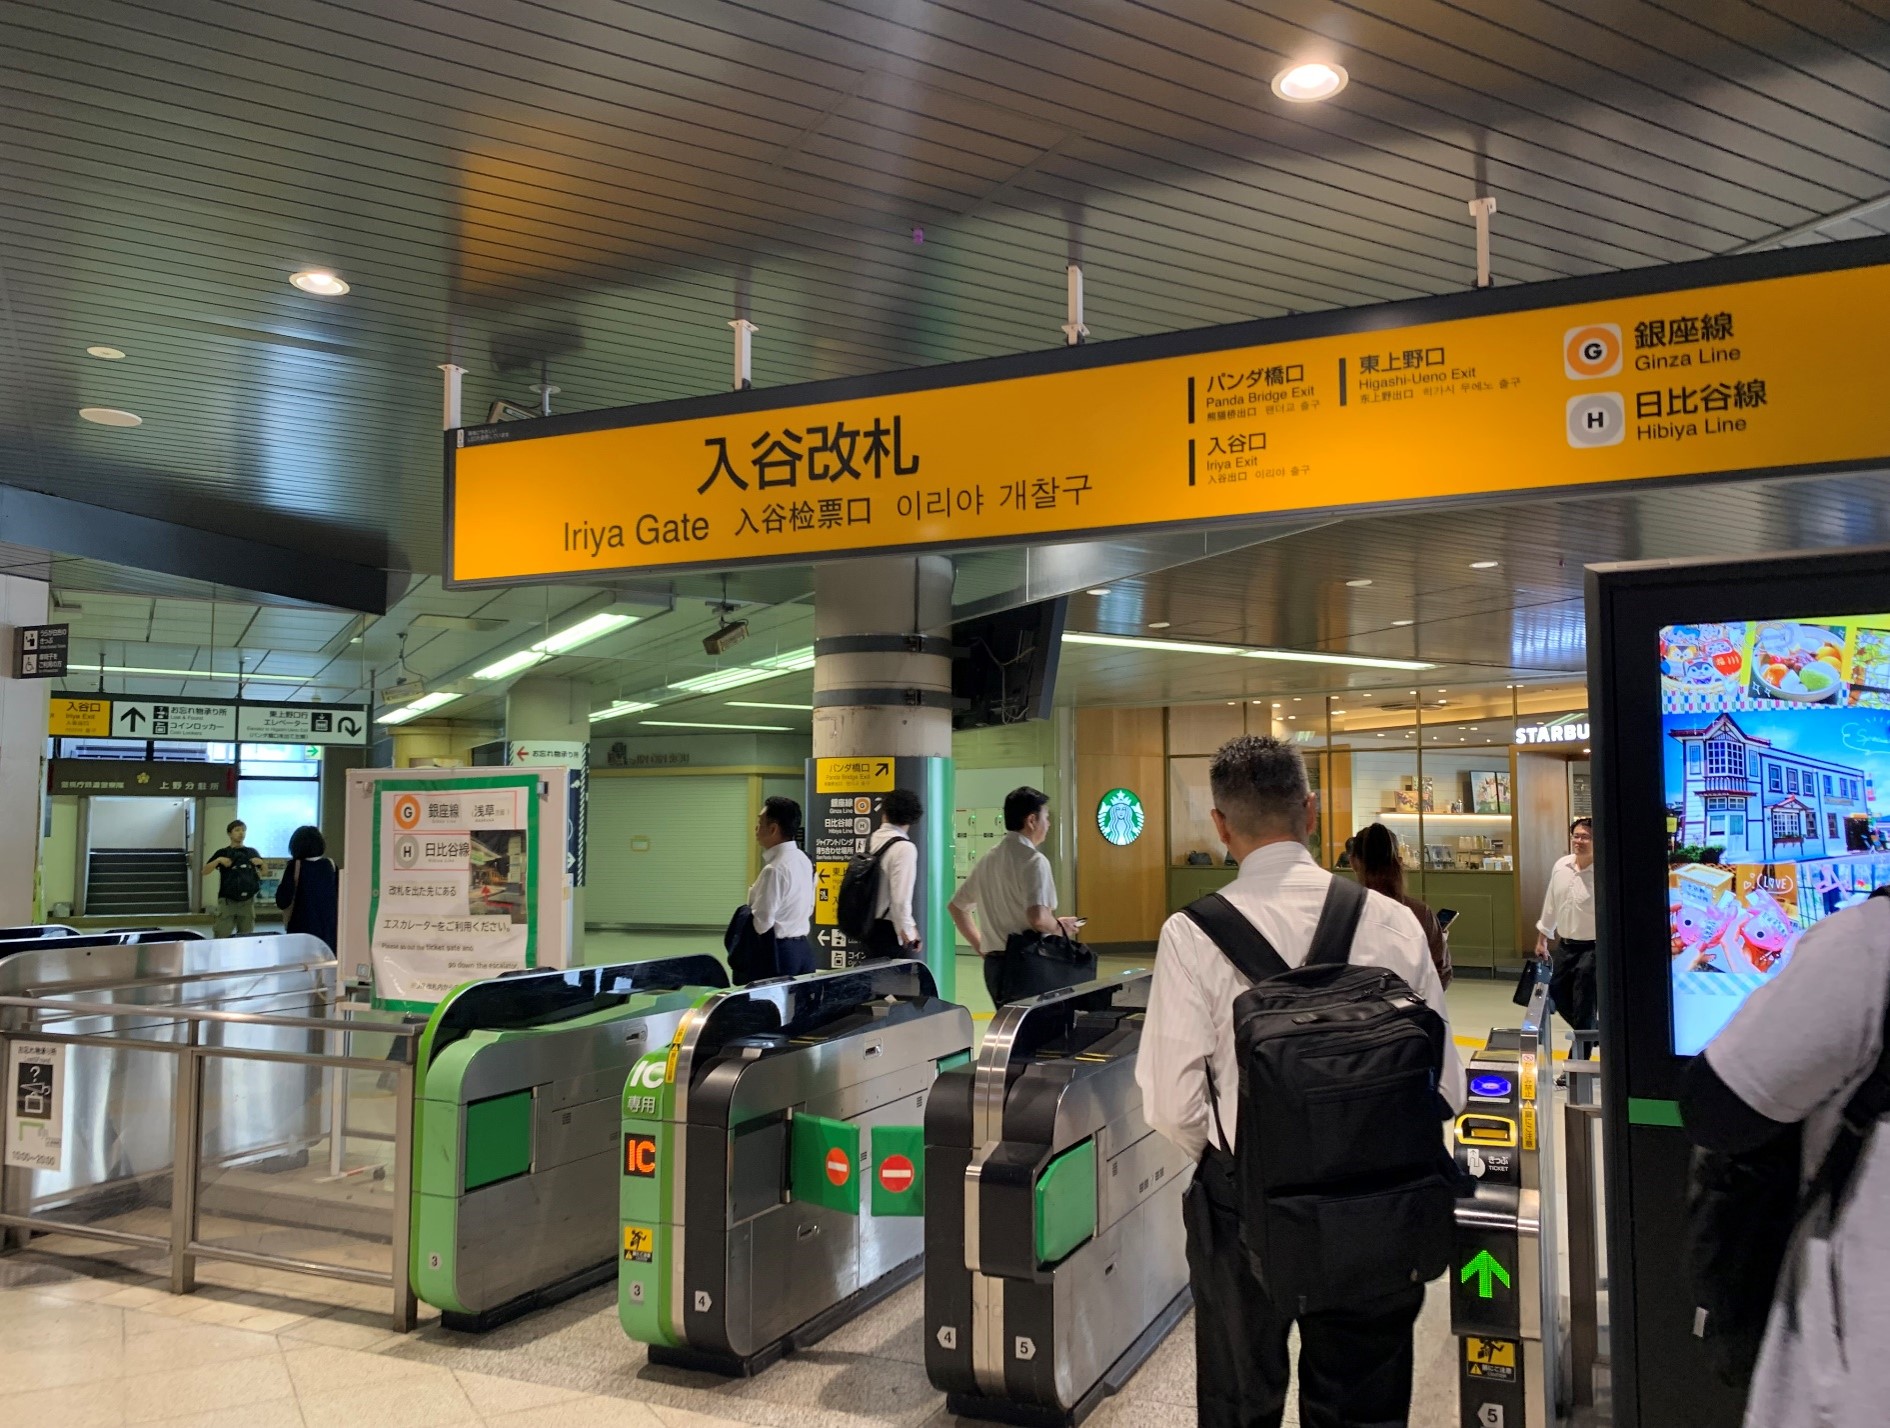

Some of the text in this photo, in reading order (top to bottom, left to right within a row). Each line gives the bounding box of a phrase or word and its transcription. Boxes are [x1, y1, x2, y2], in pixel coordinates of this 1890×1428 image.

[1634, 312, 1734, 350] 銀座線
[1584, 343, 1602, 361] G
[1635, 346, 1741, 371] Ginza Line
[1359, 347, 1445, 375] 東上野口
[1206, 364, 1304, 393] パンダ橋口
[1359, 367, 1476, 391] Higashi-Ueno Exit
[1206, 385, 1315, 409] Panda Bridge Exit
[1636, 379, 1768, 420] 日比谷線
[1587, 412, 1604, 429] H
[1637, 416, 1747, 442] Hibiya Line
[1207, 432, 1267, 456] 入谷口
[697, 416, 919, 495] 入谷改札
[1206, 456, 1258, 473] Iriya Exit
[896, 472, 1094, 522] 이리야 개찰구
[733, 497, 872, 538] 入谷检票口
[563, 511, 710, 560] Iriya Gate
[66, 702, 101, 712] 入谷口
[170, 722, 224, 731] コインロッカー
[264, 719, 308, 727] エレベーター
[1515, 723, 1591, 745] STARBU
[829, 763, 870, 773] パンダ橋口
[403, 806, 413, 819] G
[428, 803, 460, 818] 銀座線
[824, 818, 853, 827] 日比谷線
[403, 846, 412, 858] H
[425, 842, 471, 858] 日比谷線
[388, 885, 457, 897] 改札を出た先にある
[383, 919, 511, 933] エスカレーターをご利用ください。
[426, 943, 445, 951] ticket
[446, 944, 461, 952] gate
[448, 961, 457, 969] go
[458, 961, 475, 969] down
[476, 961, 488, 969] the
[630, 1060, 667, 1088] IC
[627, 1095, 655, 1114] 専用
[628, 1139, 656, 1173] IC
[1488, 1155, 1509, 1165] きっぷ
[432, 1255, 438, 1267] 3
[633, 1284, 641, 1297] 3
[698, 1295, 706, 1308] 4
[943, 1331, 952, 1343] 4
[1019, 1341, 1029, 1355] 5
[1487, 1408, 1498, 1423] 5
